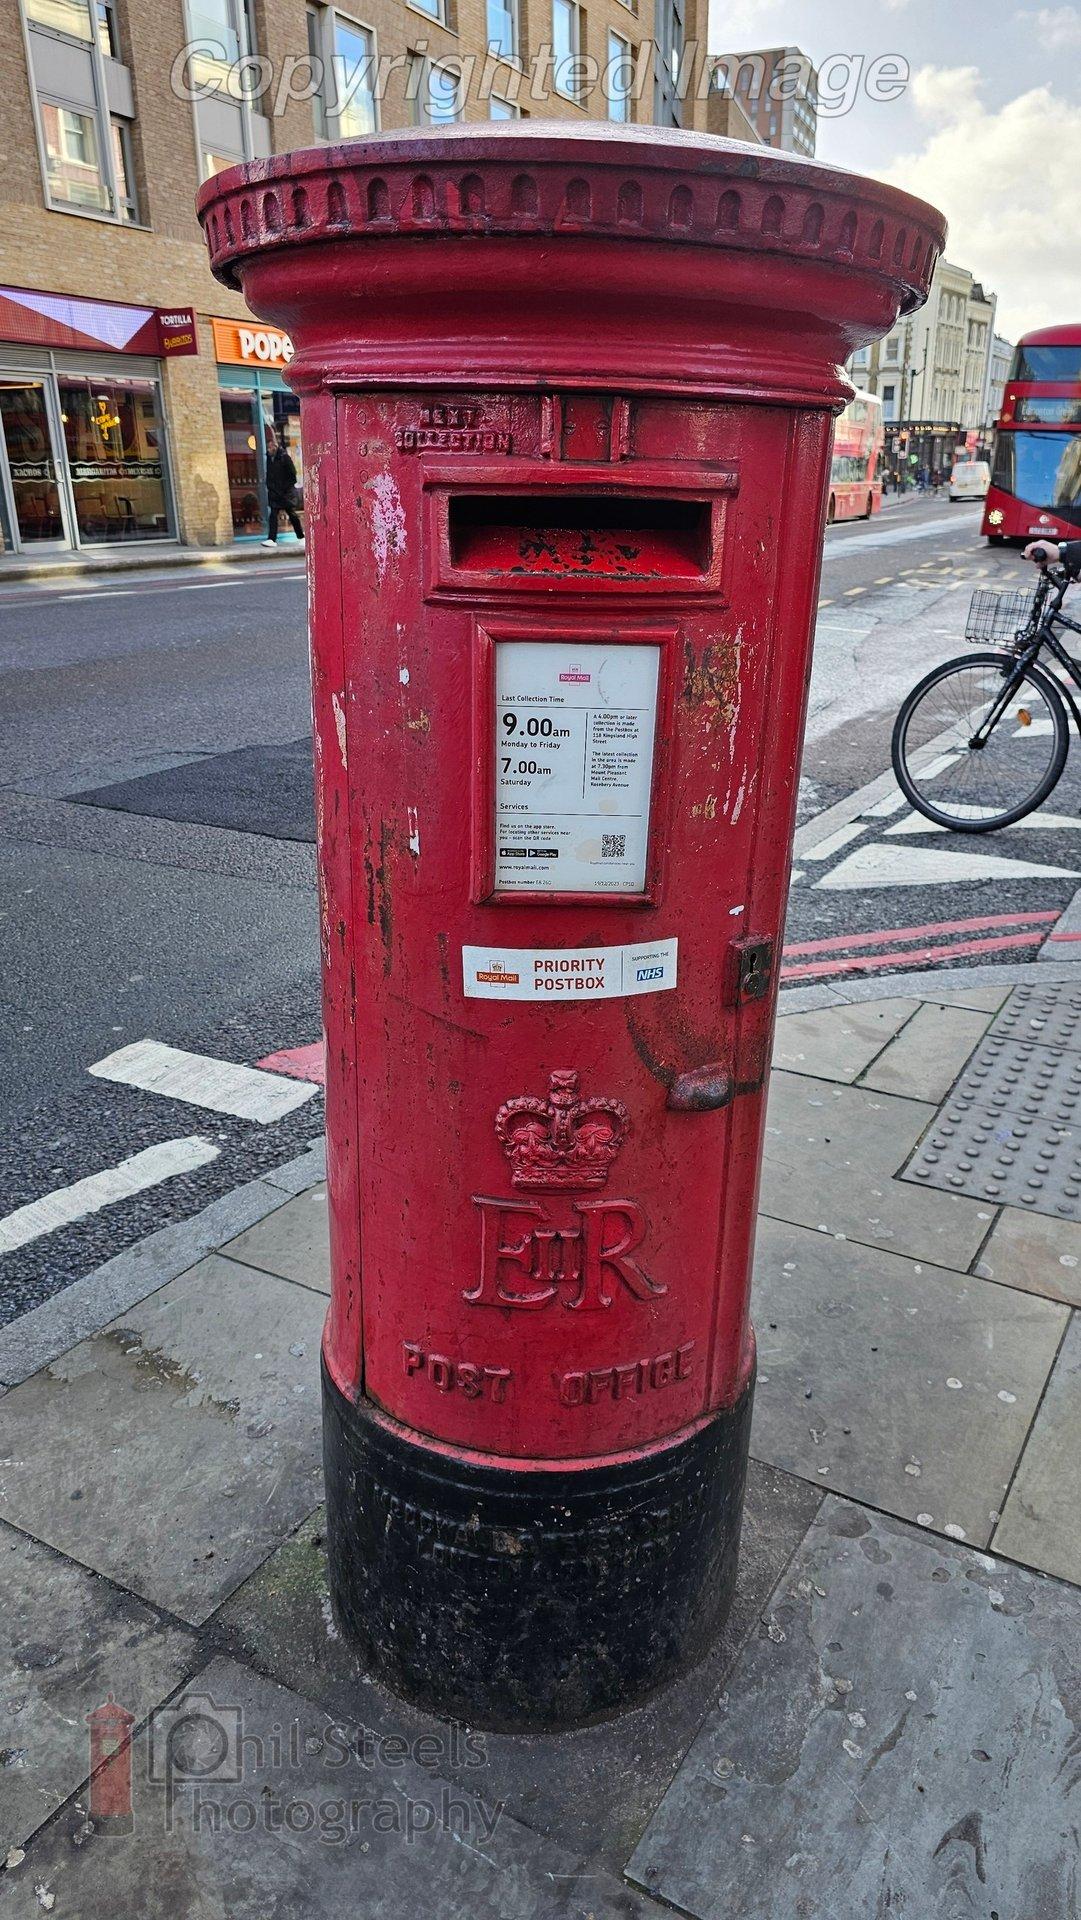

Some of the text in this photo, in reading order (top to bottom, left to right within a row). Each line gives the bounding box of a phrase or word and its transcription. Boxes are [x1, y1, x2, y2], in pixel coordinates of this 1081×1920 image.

[160, 314, 192, 326] TORTILLA
[560, 674, 576, 682] Royal
[501, 694, 565, 703] Last Collection Time
[502, 712, 571, 738] 9.00am
[501, 740, 528, 749] Monday
[539, 741, 561, 750] Friday
[501, 757, 552, 775] 7.00am
[500, 778, 532, 787] Saturday
[500, 802, 529, 811] Services
[631, 953, 660, 961] SUPPORTING
[534, 958, 605, 973] PRIORITY
[478, 974, 517, 983] Royal Mail
[638, 967, 663, 981] NHS
[534, 976, 605, 990] POSTBOX
[402, 1340, 696, 1406] POST OFFICE
